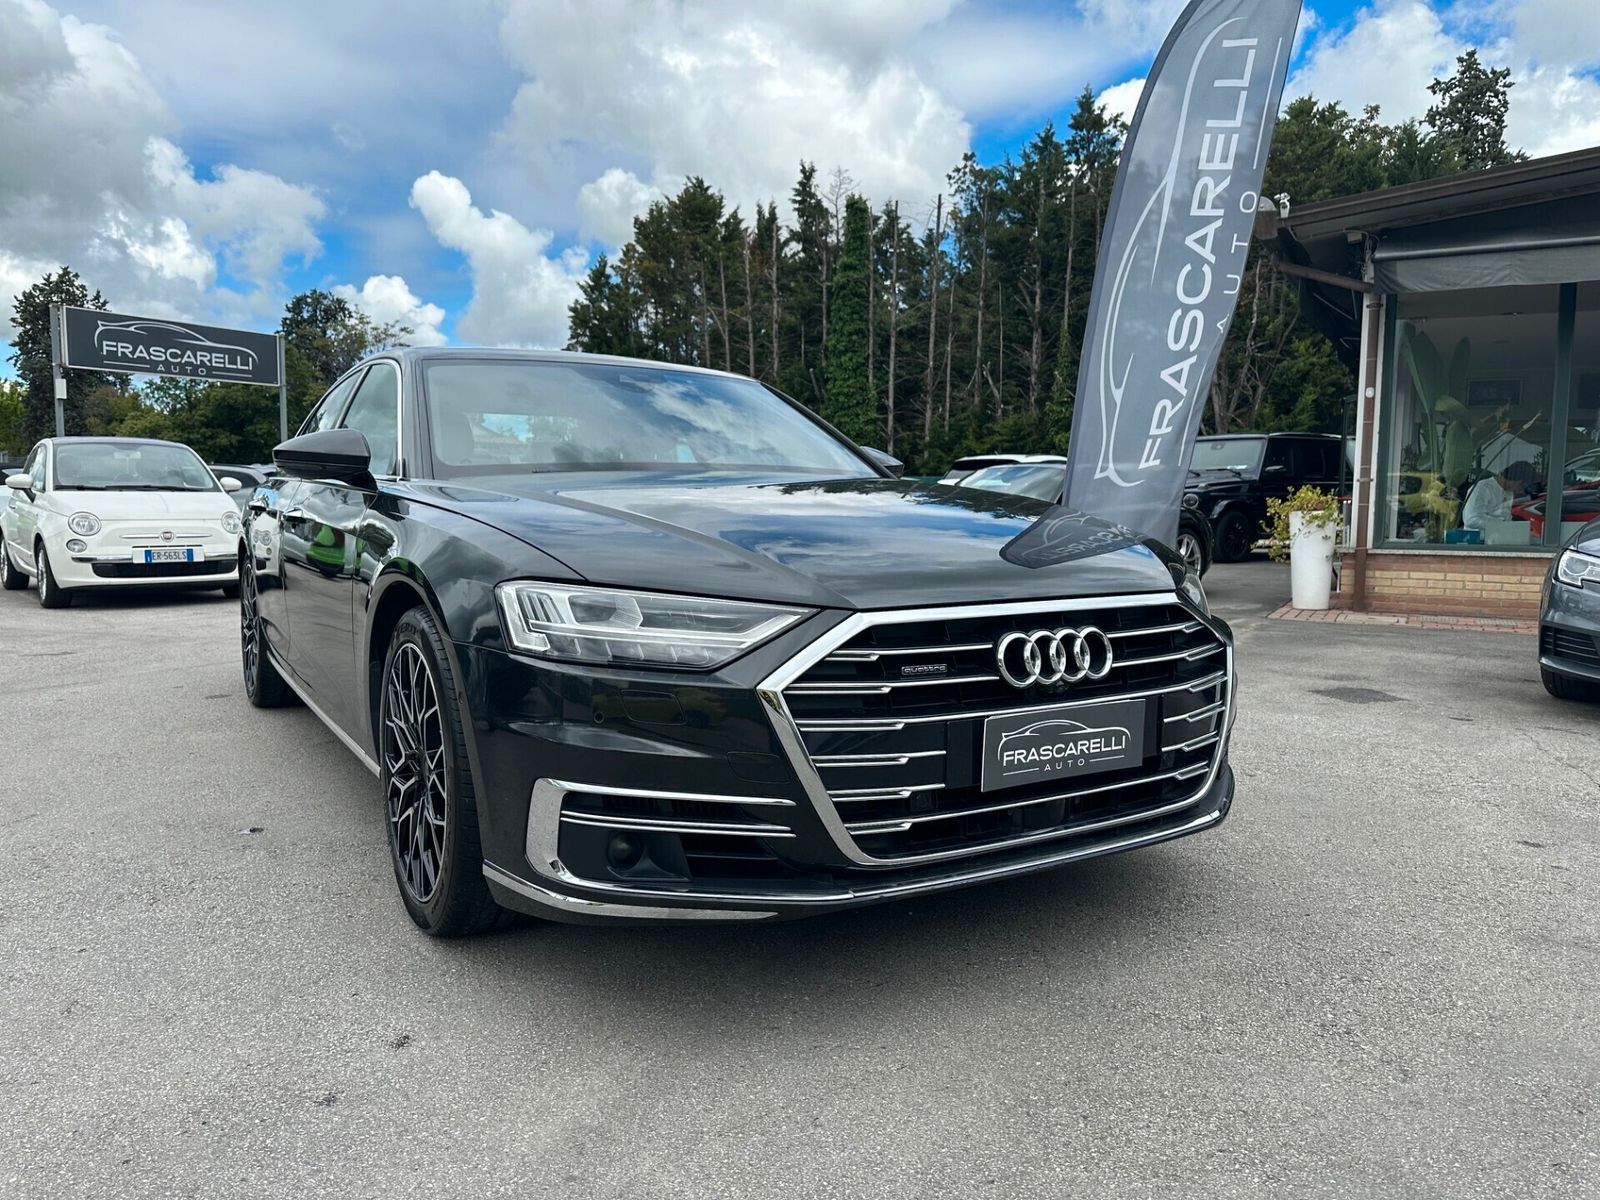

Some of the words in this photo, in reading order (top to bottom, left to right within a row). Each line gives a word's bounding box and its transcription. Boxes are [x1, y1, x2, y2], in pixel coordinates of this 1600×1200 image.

[1138, 37, 1258, 470] FRASCARELLI
[1216, 190, 1257, 334] AUTO
[102, 340, 253, 371] FRASCARELLI
[157, 363, 207, 376] AUTO
[1003, 735, 1126, 767] FRASCARELLI
[1044, 758, 1085, 772] AUTO
